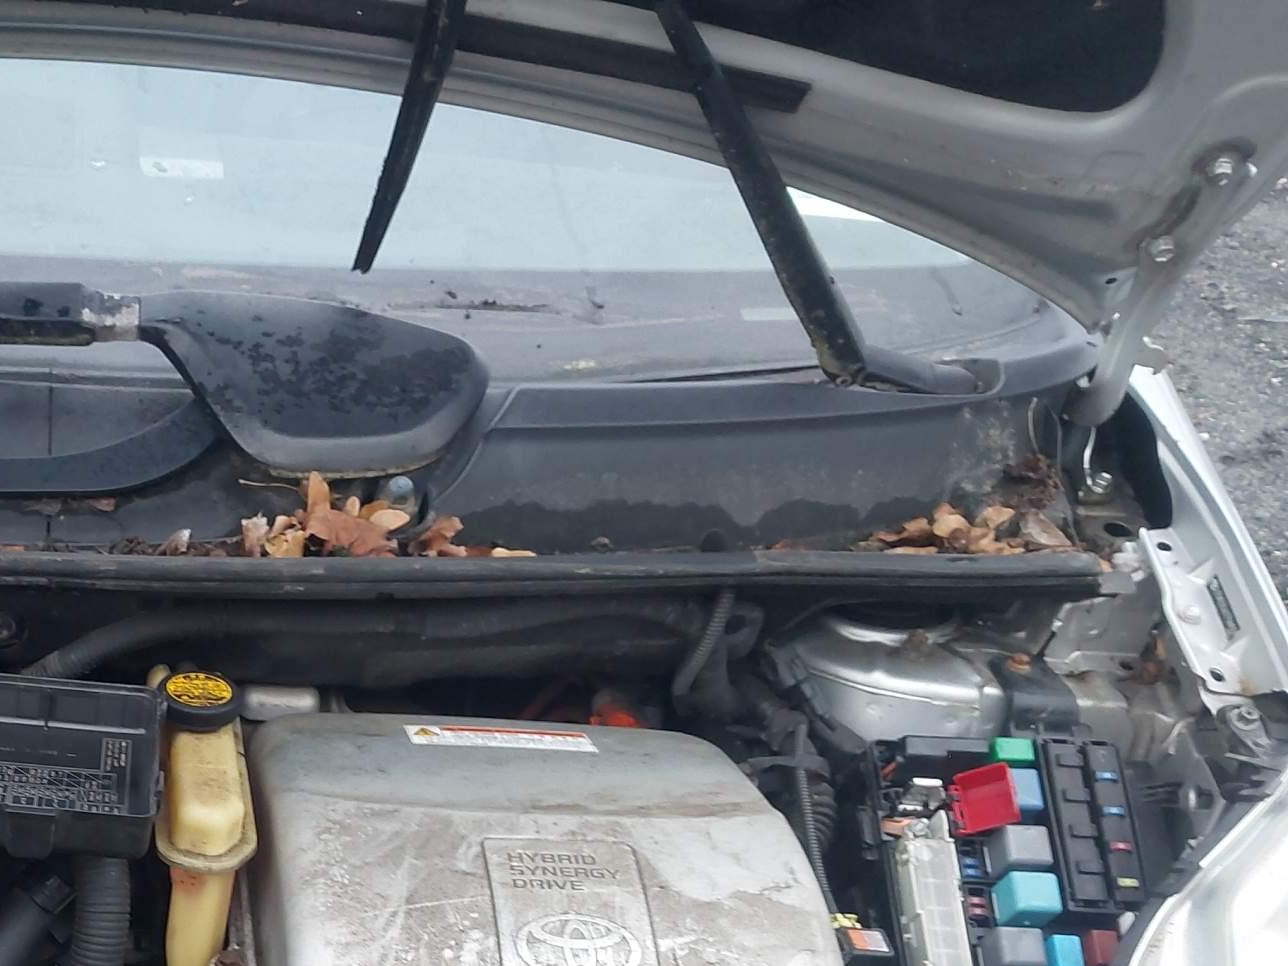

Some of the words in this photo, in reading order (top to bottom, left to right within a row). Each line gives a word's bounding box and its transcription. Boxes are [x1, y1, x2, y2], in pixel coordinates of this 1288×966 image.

[506, 852, 597, 865] HYBRID
[509, 864, 620, 879] SYNERGY
[511, 878, 585, 891] DRIVE
